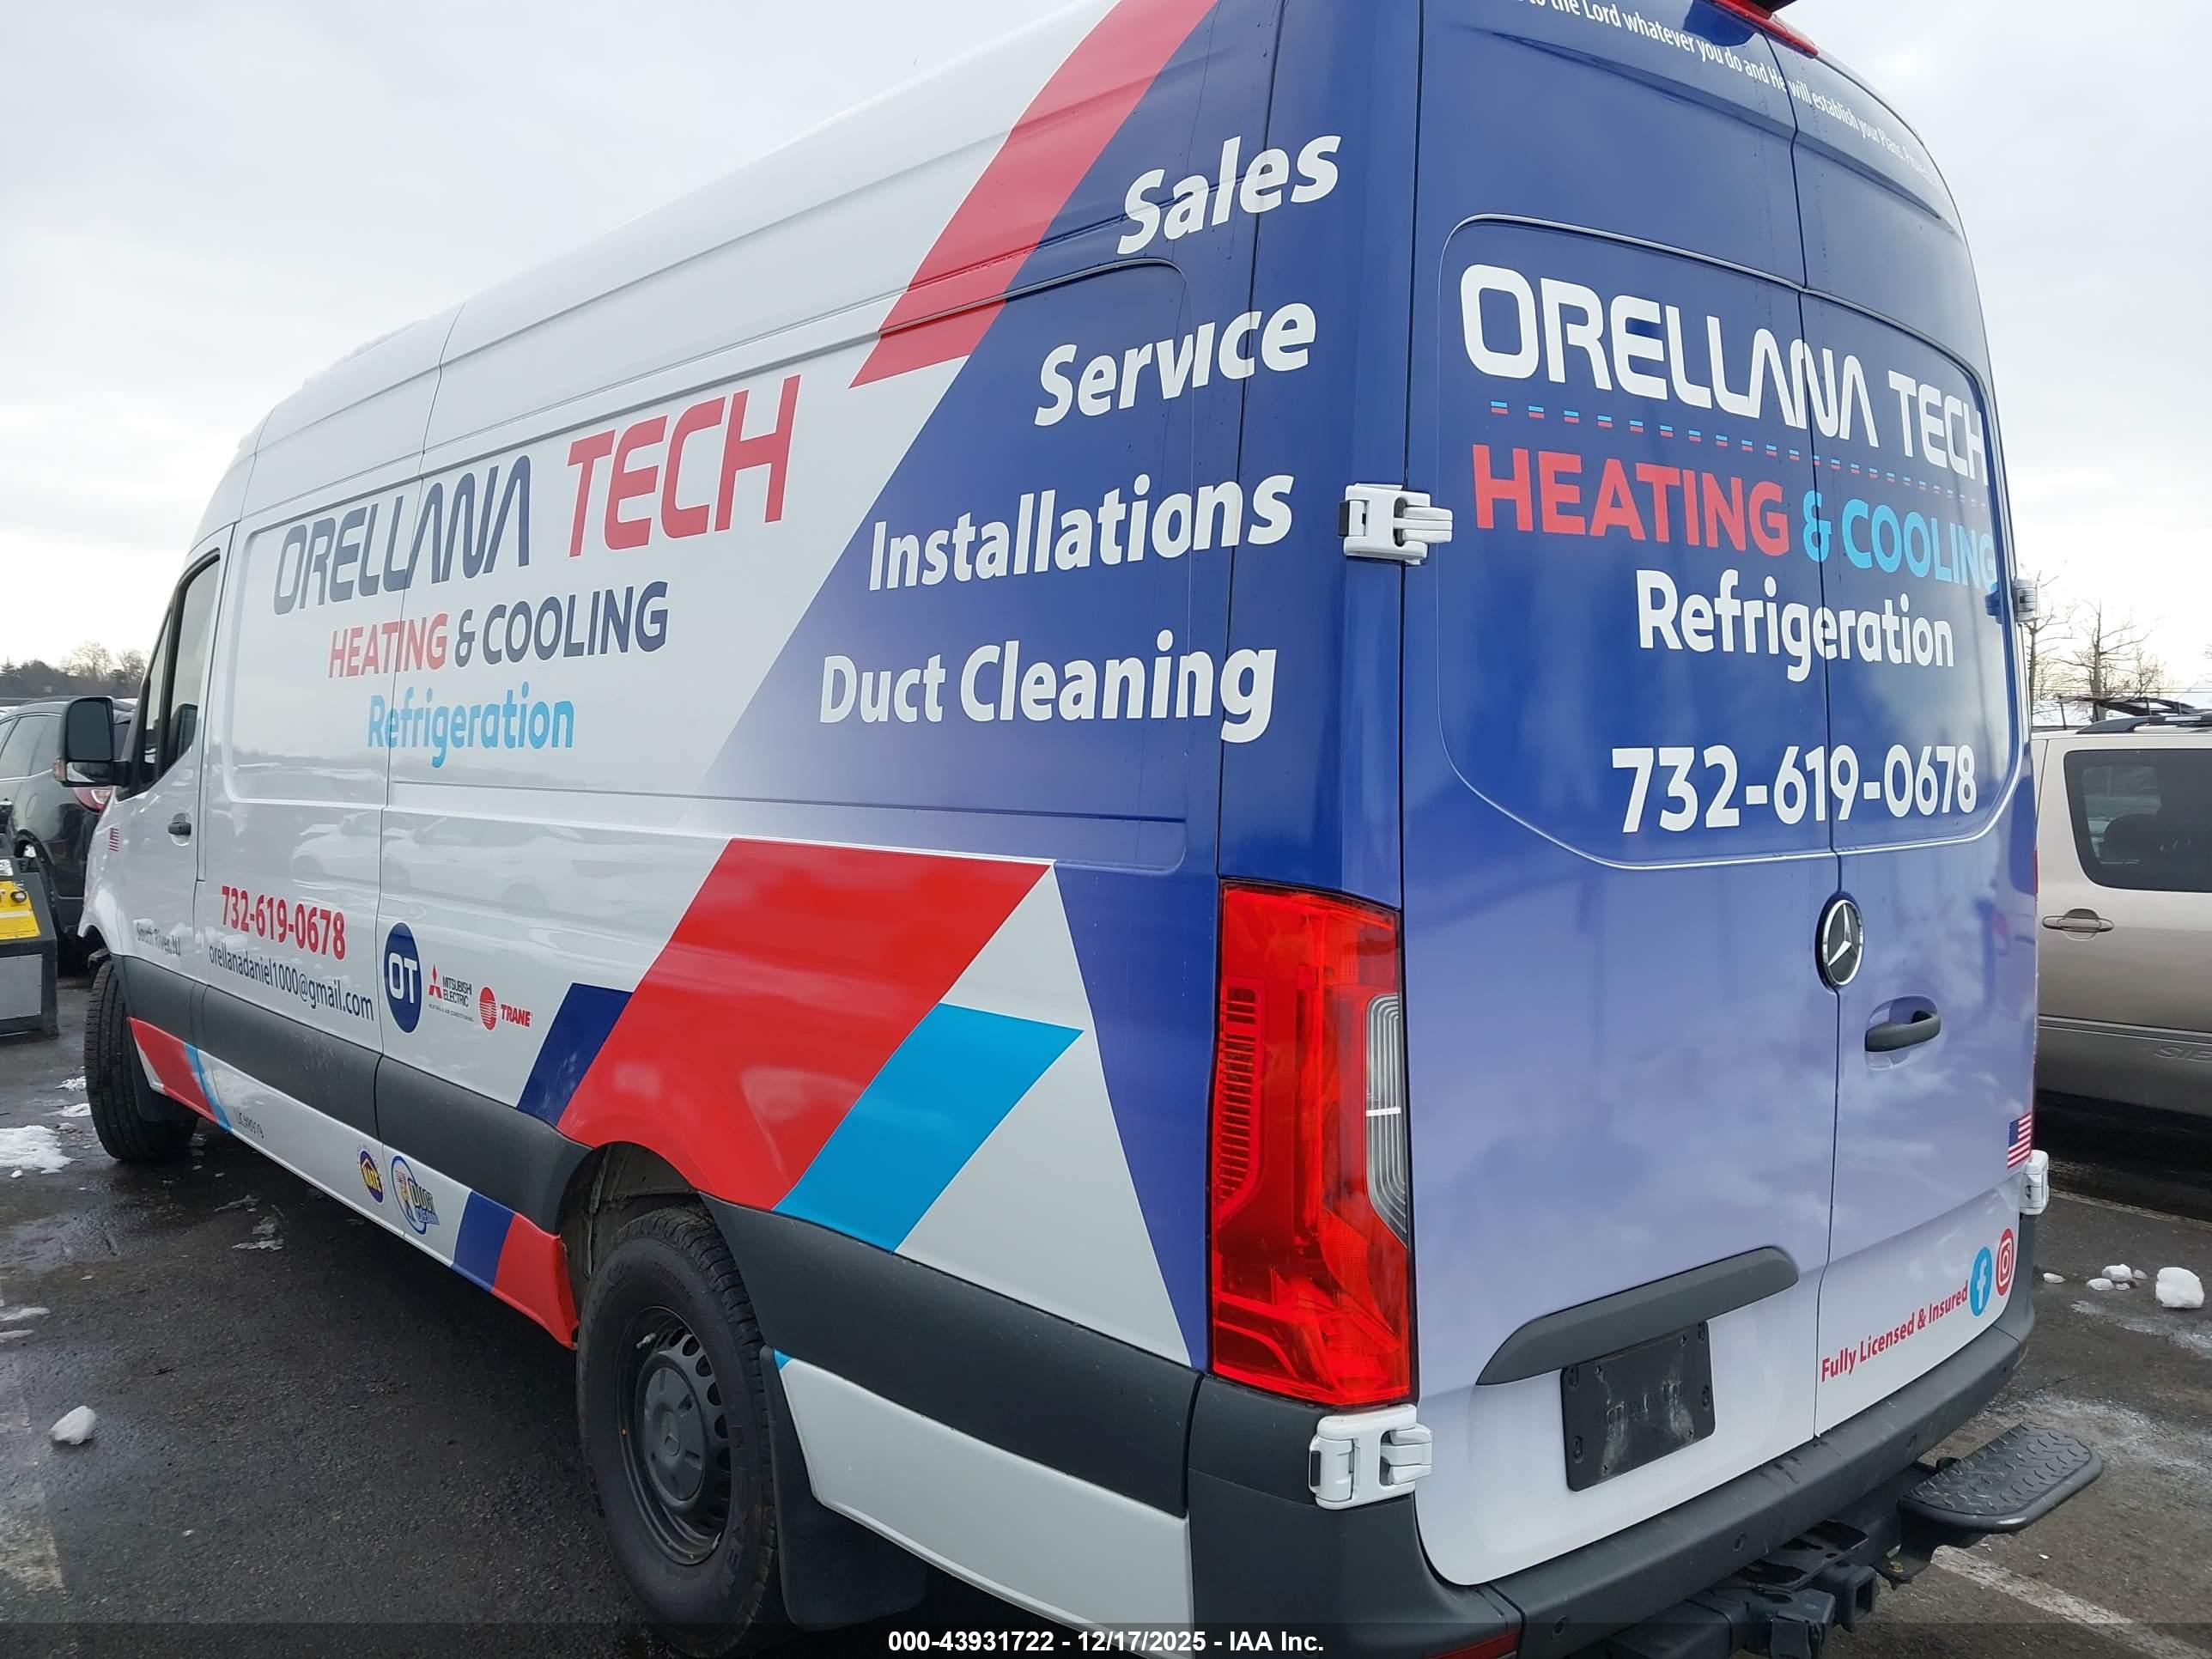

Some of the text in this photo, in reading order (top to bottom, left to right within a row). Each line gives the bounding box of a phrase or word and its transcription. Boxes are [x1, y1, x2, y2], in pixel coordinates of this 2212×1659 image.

[1584, 0, 1622, 27] Lord
[1622, 12, 1695, 53] whatever
[1696, 40, 1723, 63] you
[1725, 47, 1743, 72] do
[1744, 59, 1770, 84] and
[1767, 66, 1788, 93] He
[1788, 80, 1812, 105] will
[1812, 91, 1860, 131] establish
[1857, 118, 1881, 144] your
[1116, 135, 1342, 255] Sales
[1034, 301, 1317, 427] Service
[1460, 263, 1990, 486] ORELLANA TECH
[273, 374, 802, 615] ORELLANA TECH
[868, 473, 1295, 591] Installations
[1472, 444, 1998, 594] HEATING & COOLING
[328, 580, 669, 678] HEATING & COOLING
[1636, 568, 1954, 682] Refrigeration
[367, 681, 575, 769] Refrigeration
[819, 629, 1278, 744] Duct Cleaning
[1611, 744, 1978, 834] 732-619-0678
[222, 885, 346, 960] 732-619-0678
[209, 942, 374, 1022] orellanadaniel1000@gmail.com
[389, 952, 418, 1005] OT
[442, 975, 472, 996] MITSUBISHI
[443, 988, 470, 1008] ELECTRIC
[501, 1004, 531, 1028] TRANE
[1821, 1347, 1856, 1382] Fully
[1859, 1311, 1916, 1363] Licensed
[1917, 1308, 1927, 1330] &
[1929, 1279, 1968, 1324] Insured
